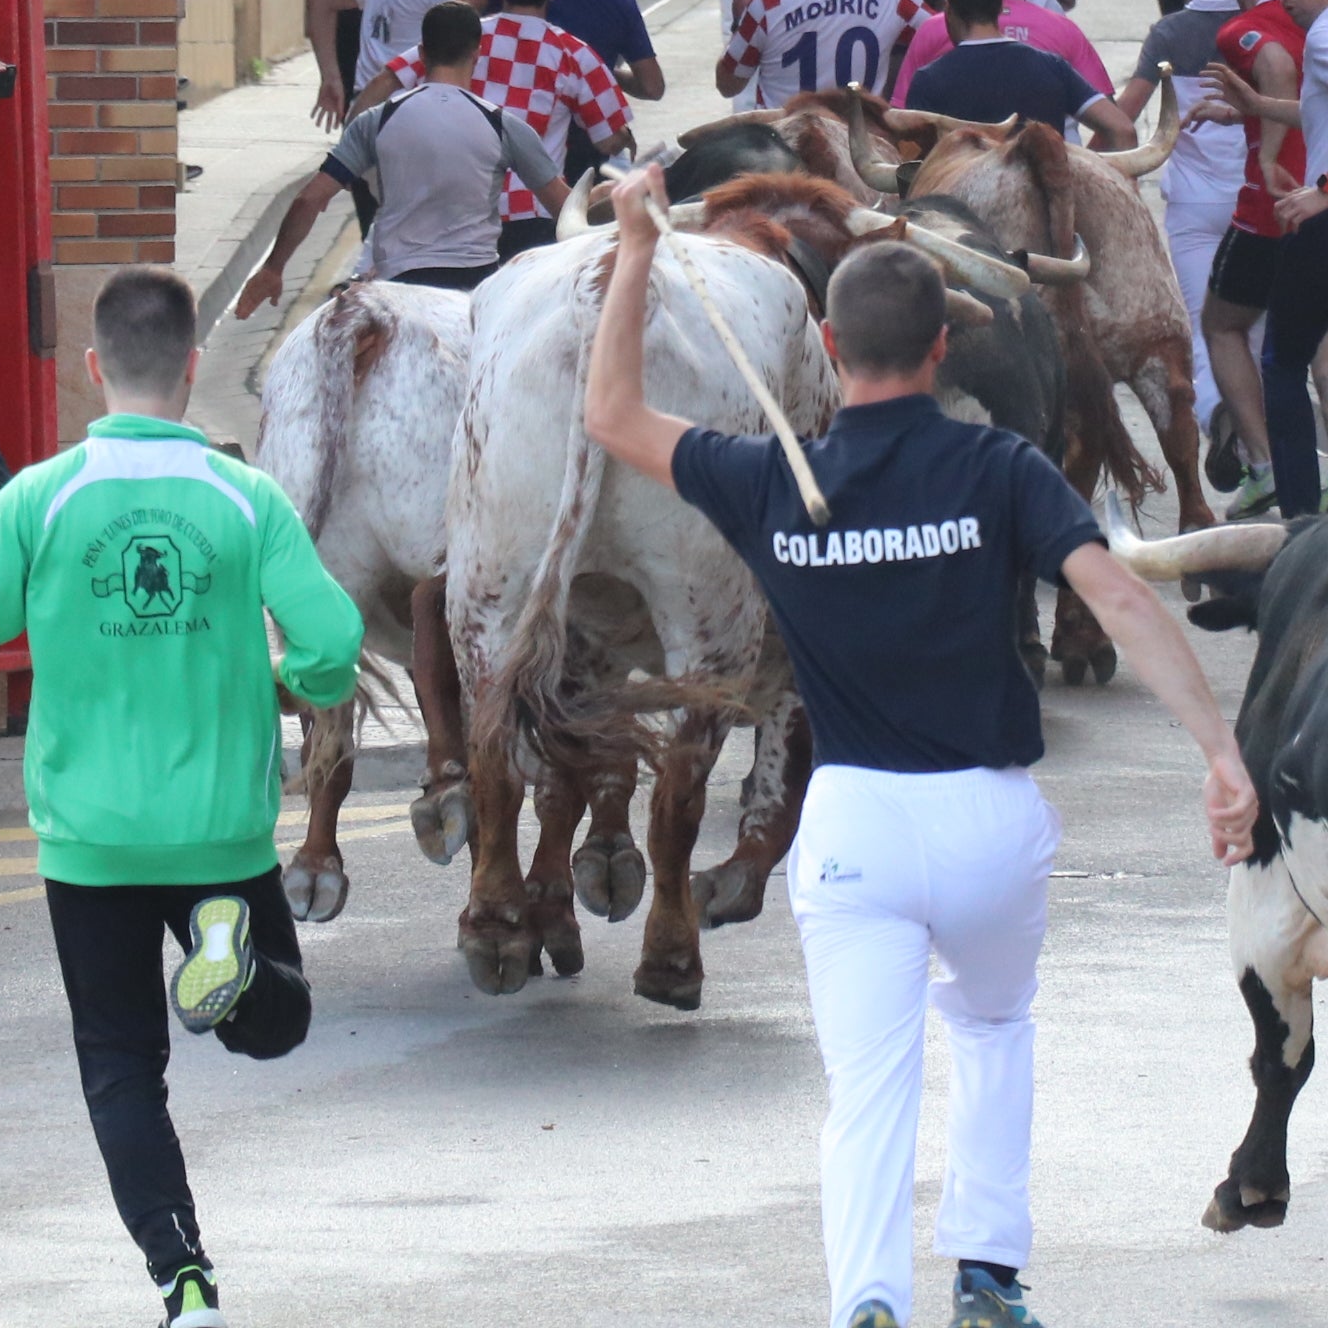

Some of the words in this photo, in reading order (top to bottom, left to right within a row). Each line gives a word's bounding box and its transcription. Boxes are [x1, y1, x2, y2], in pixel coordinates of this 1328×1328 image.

[781, 26, 880, 92] 10
[773, 517, 981, 567] COLABORADOR
[100, 616, 211, 637] GRAZALEMA
